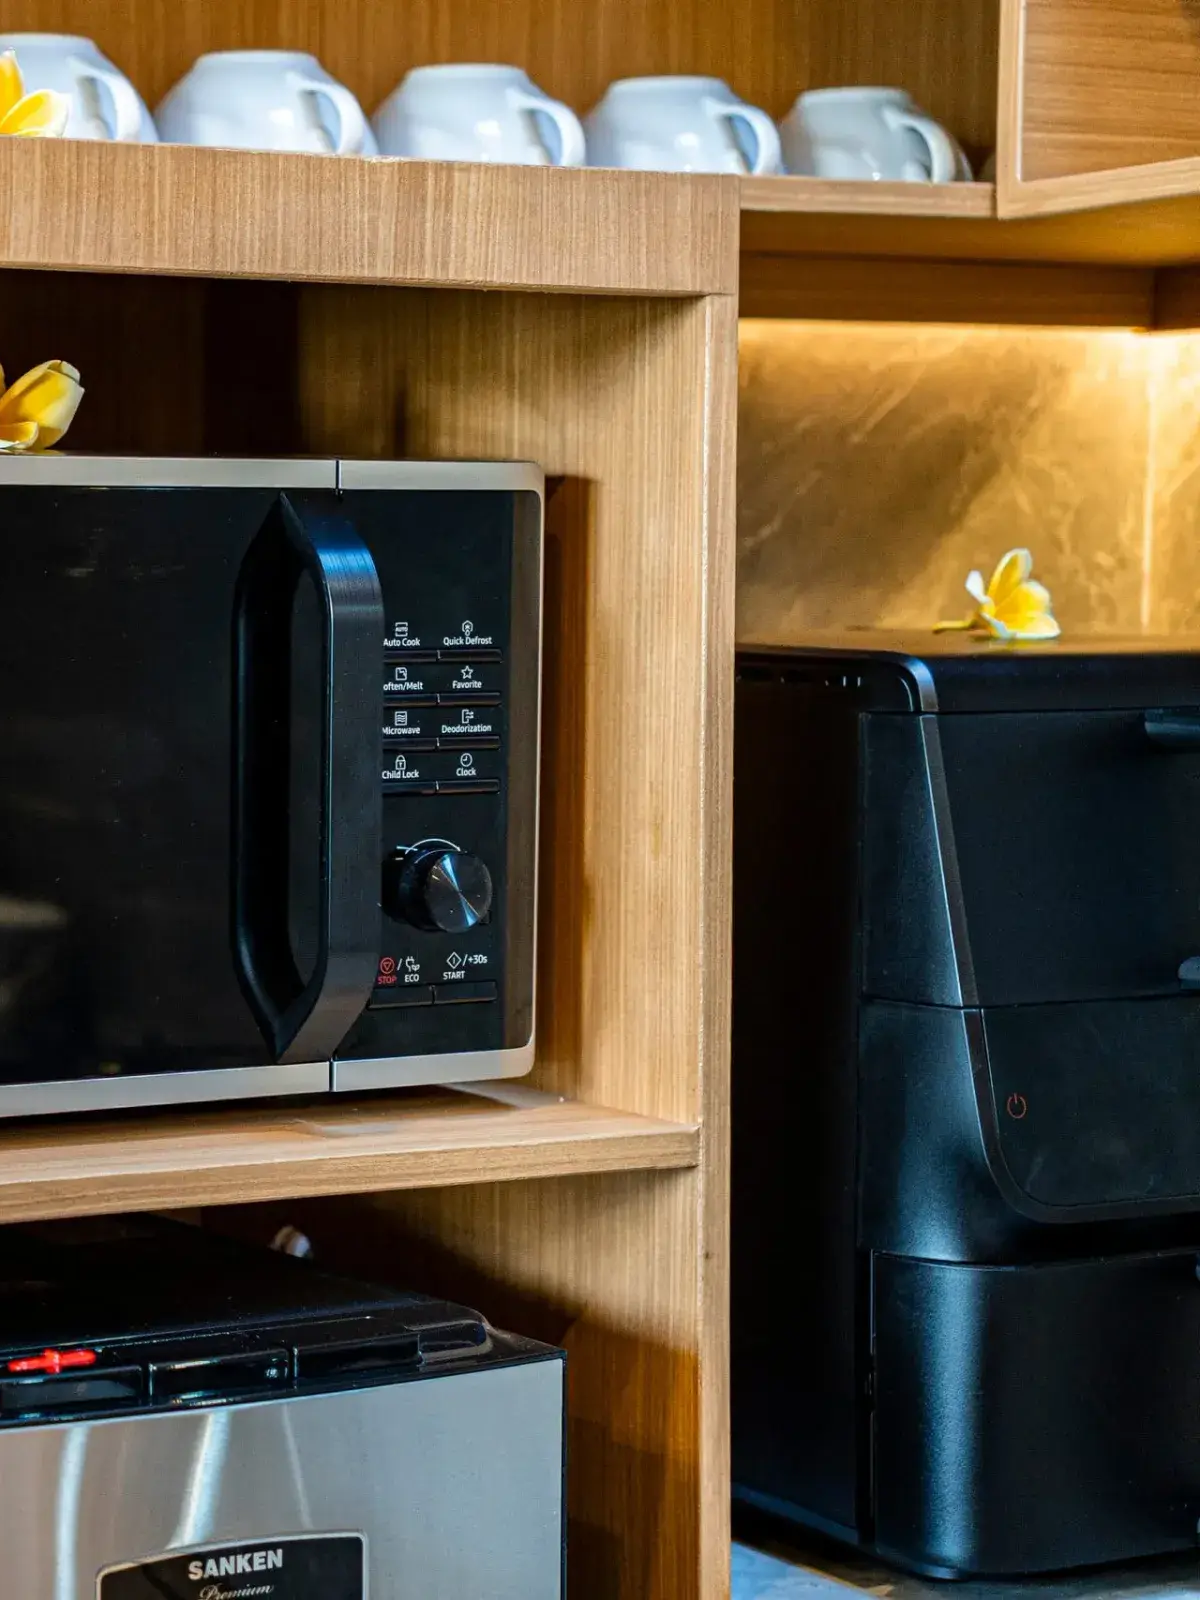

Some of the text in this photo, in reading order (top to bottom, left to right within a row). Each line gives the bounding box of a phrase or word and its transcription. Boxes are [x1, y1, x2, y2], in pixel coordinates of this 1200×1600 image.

[383, 637, 420, 647] Auto Cook
[443, 635, 492, 646] Quick Defrost
[383, 681, 423, 691] often/Melt
[452, 680, 482, 689] Favorite
[382, 726, 420, 735] Microwave
[441, 724, 492, 734] Deodorization
[382, 769, 419, 779] Child Lock
[456, 767, 476, 776] Clock
[377, 974, 398, 985] STOP
[404, 973, 420, 983] ECO
[443, 970, 465, 980] START
[188, 1548, 283, 1580] SANKEN
[197, 1582, 275, 1600] Premium
